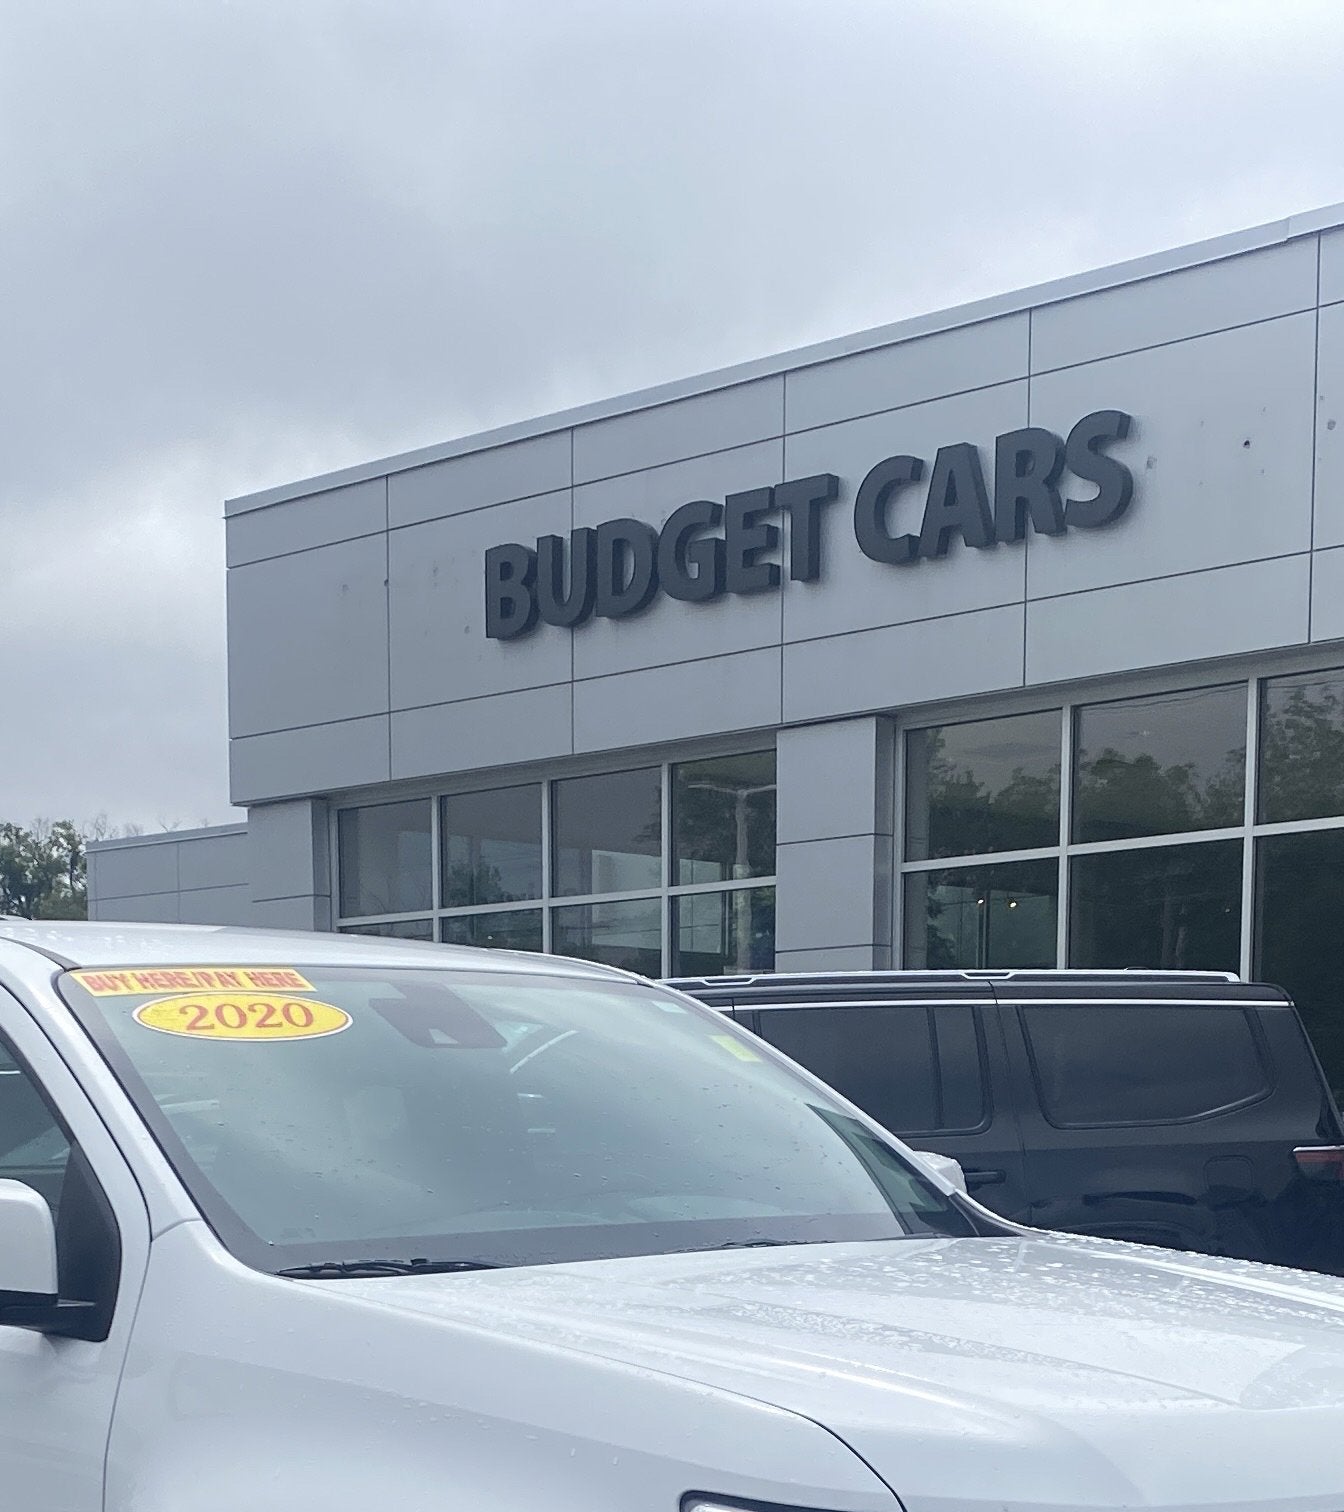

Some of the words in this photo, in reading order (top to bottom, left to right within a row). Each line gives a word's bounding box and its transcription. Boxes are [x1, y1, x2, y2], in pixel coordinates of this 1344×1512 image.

[485, 473, 839, 639] BUDGET
[854, 409, 1136, 565] CARS
[81, 973, 132, 992] BUY
[242, 970, 308, 988] HERE
[179, 1002, 314, 1031] 2020
